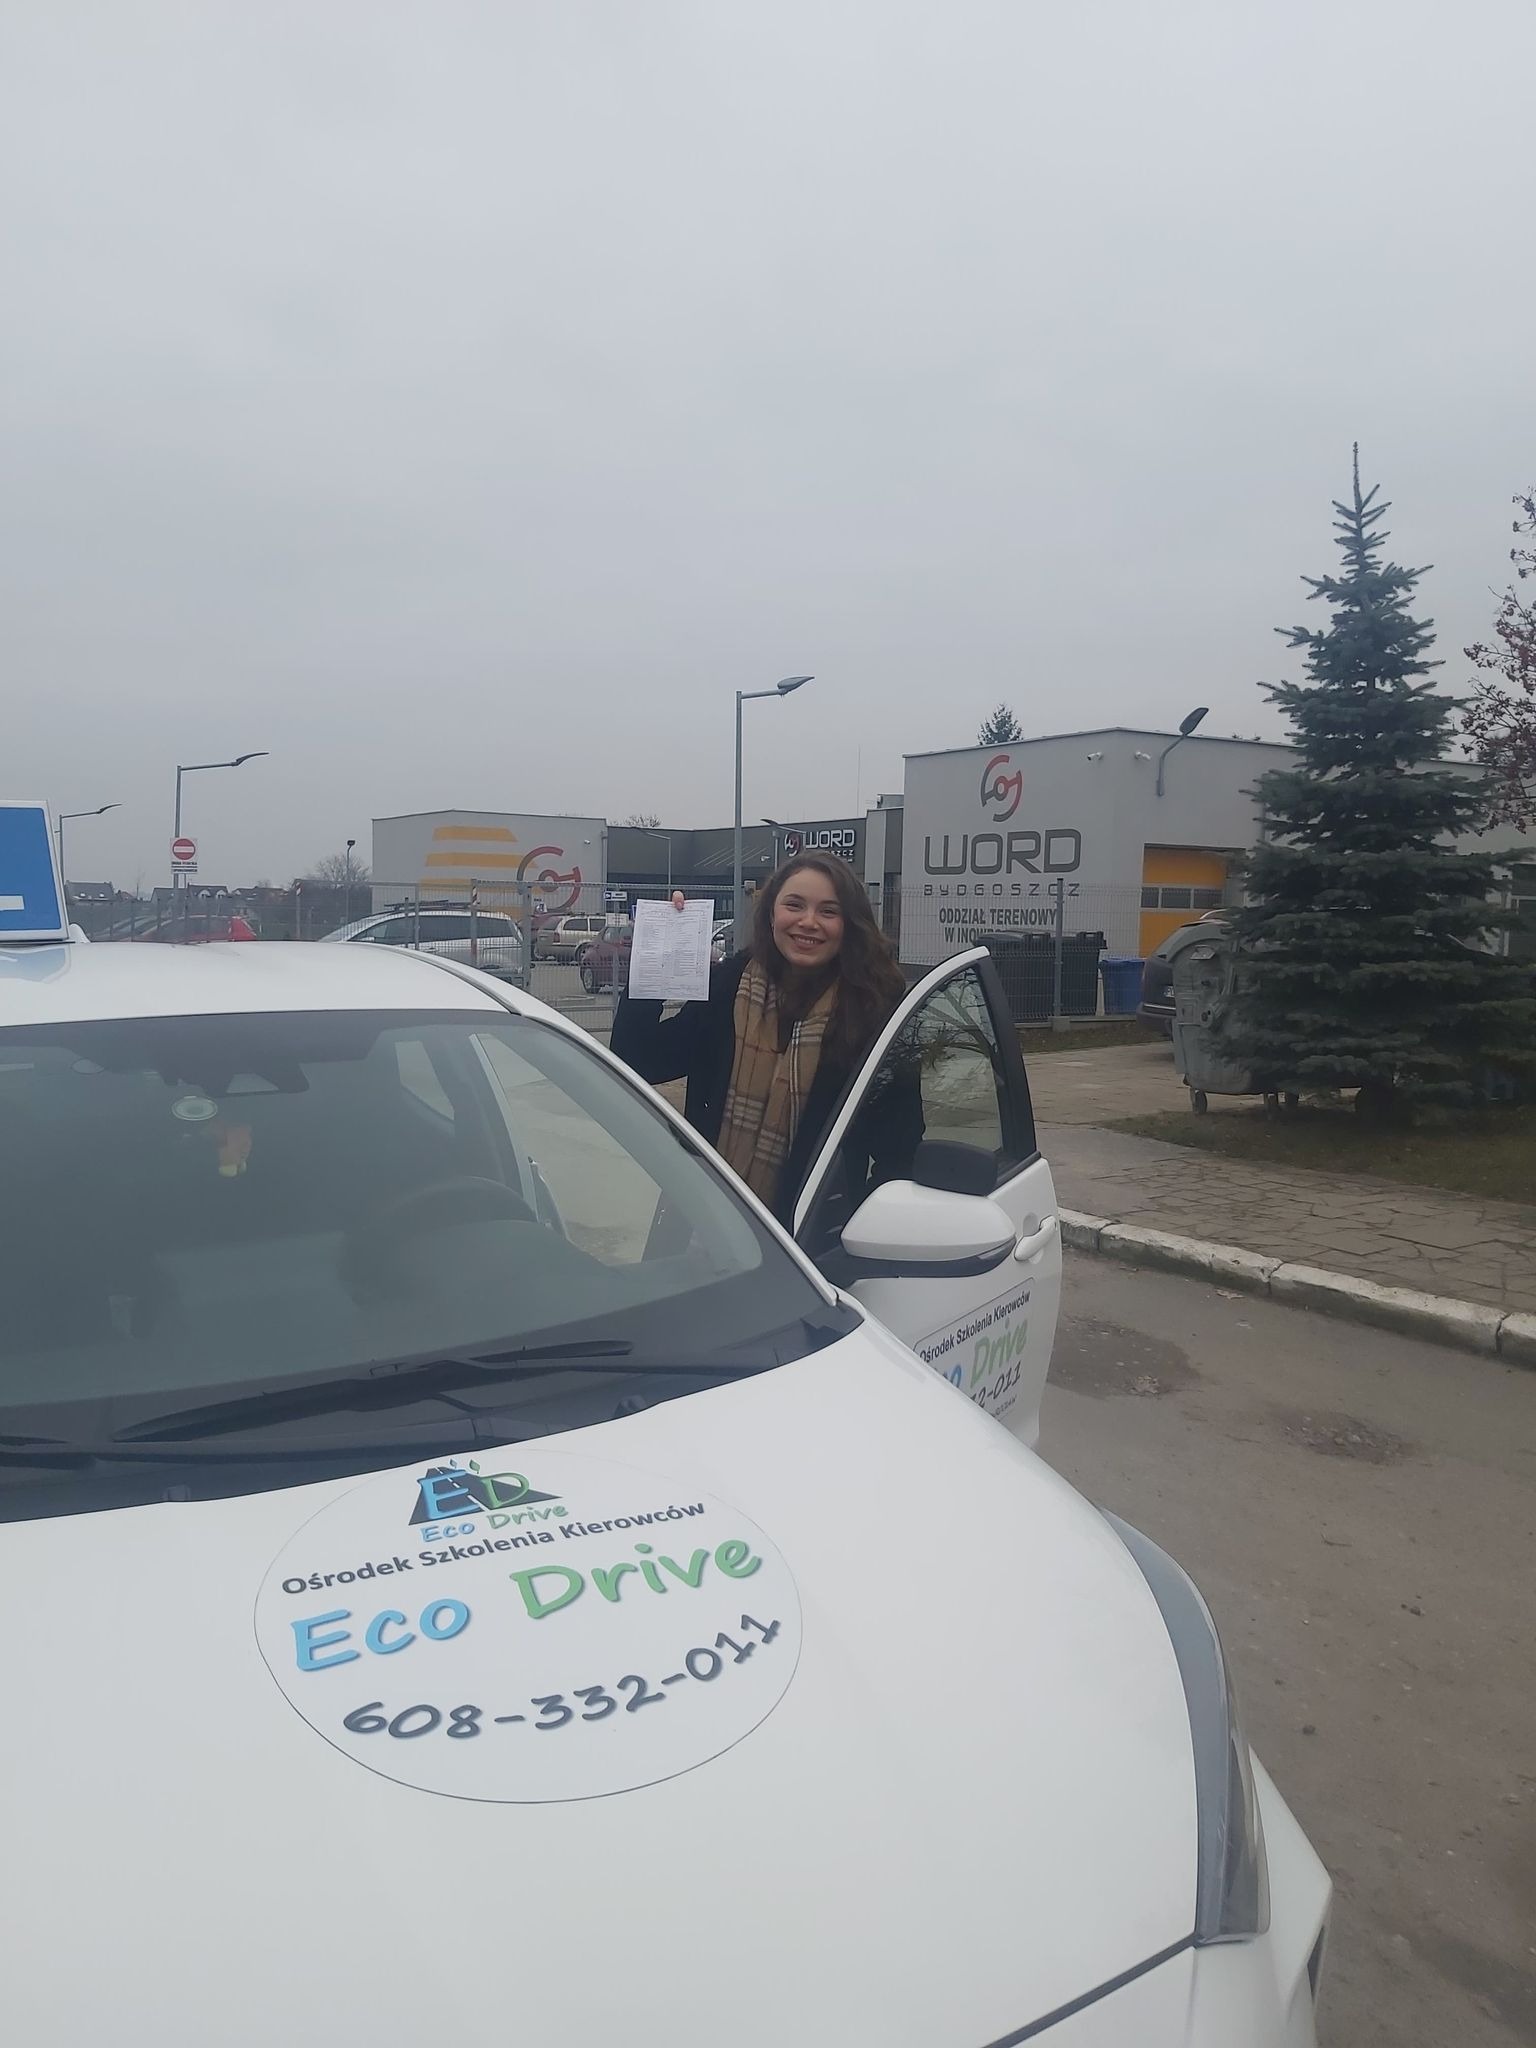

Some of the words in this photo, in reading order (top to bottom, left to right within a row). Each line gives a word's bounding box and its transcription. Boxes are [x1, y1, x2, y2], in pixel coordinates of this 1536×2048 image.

[803, 829, 855, 849] WORD
[924, 828, 1082, 875] WORD
[939, 907, 986, 924] ODDZIAŁ
[990, 908, 1057, 925] TERENOWY
[944, 927, 955, 942] W
[920, 1334, 955, 1363] Ośrodek
[956, 1312, 992, 1345] Szkolenia
[993, 1290, 1031, 1322] Kierowców
[970, 1317, 1028, 1389] Drive
[281, 1554, 411, 1595] Ośrodek
[418, 1529, 556, 1567] Szkolenia
[559, 1502, 706, 1539] Kierowców
[420, 1522, 475, 1542] Eco
[487, 1505, 569, 1529] Drive
[290, 1597, 471, 1673] Eco
[510, 1539, 763, 1620] Drive
[343, 1612, 781, 1739] 608-332-011
